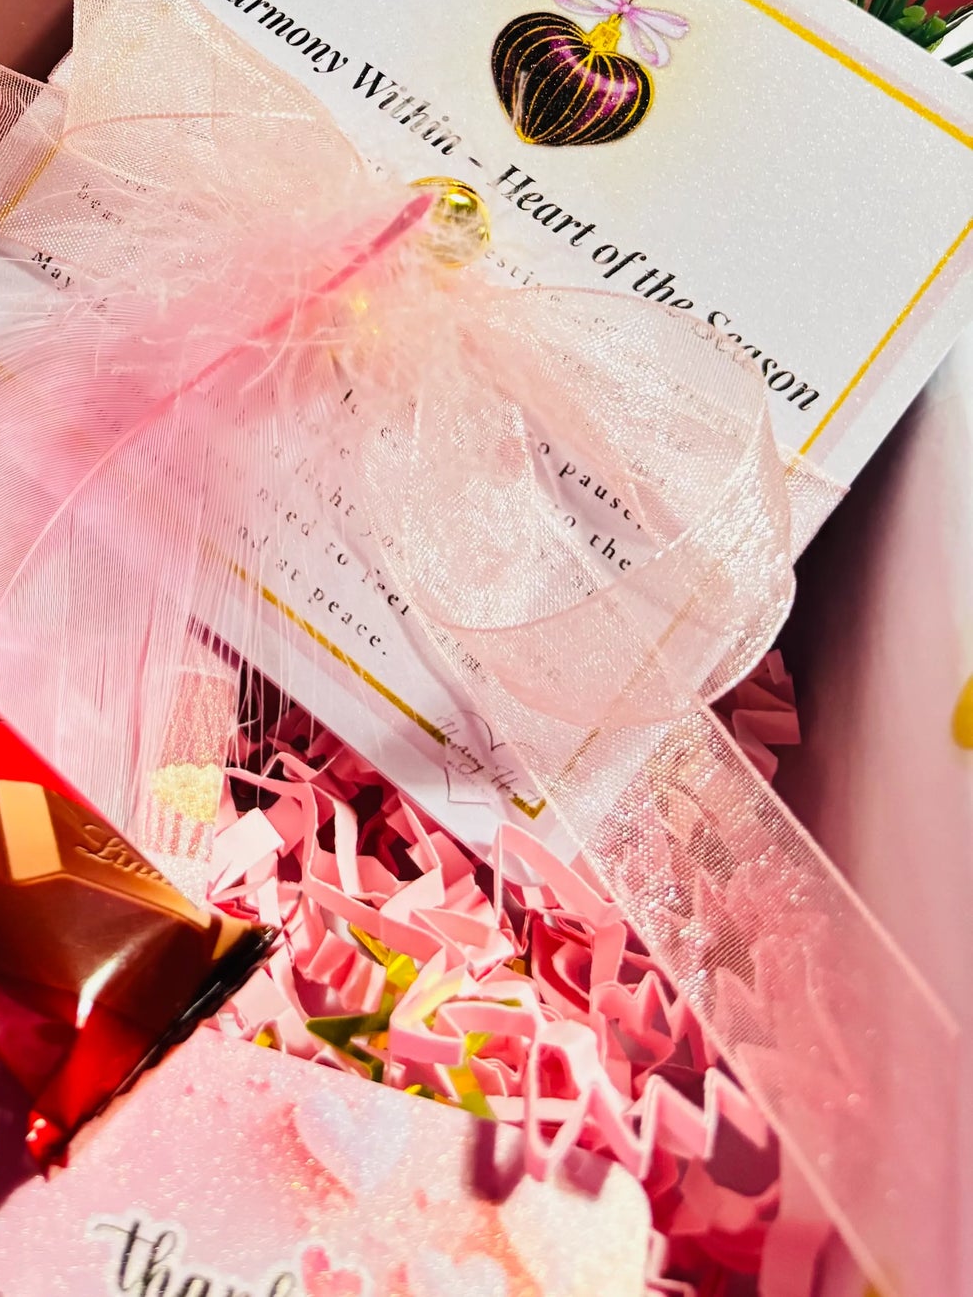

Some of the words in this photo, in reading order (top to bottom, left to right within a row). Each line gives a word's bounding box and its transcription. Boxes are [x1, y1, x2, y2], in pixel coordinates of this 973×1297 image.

[352, 60, 463, 157] Within
[487, 163, 603, 249] Heart
[591, 243, 647, 280] of
[631, 264, 695, 312] the
[308, 585, 387, 656] peace.
